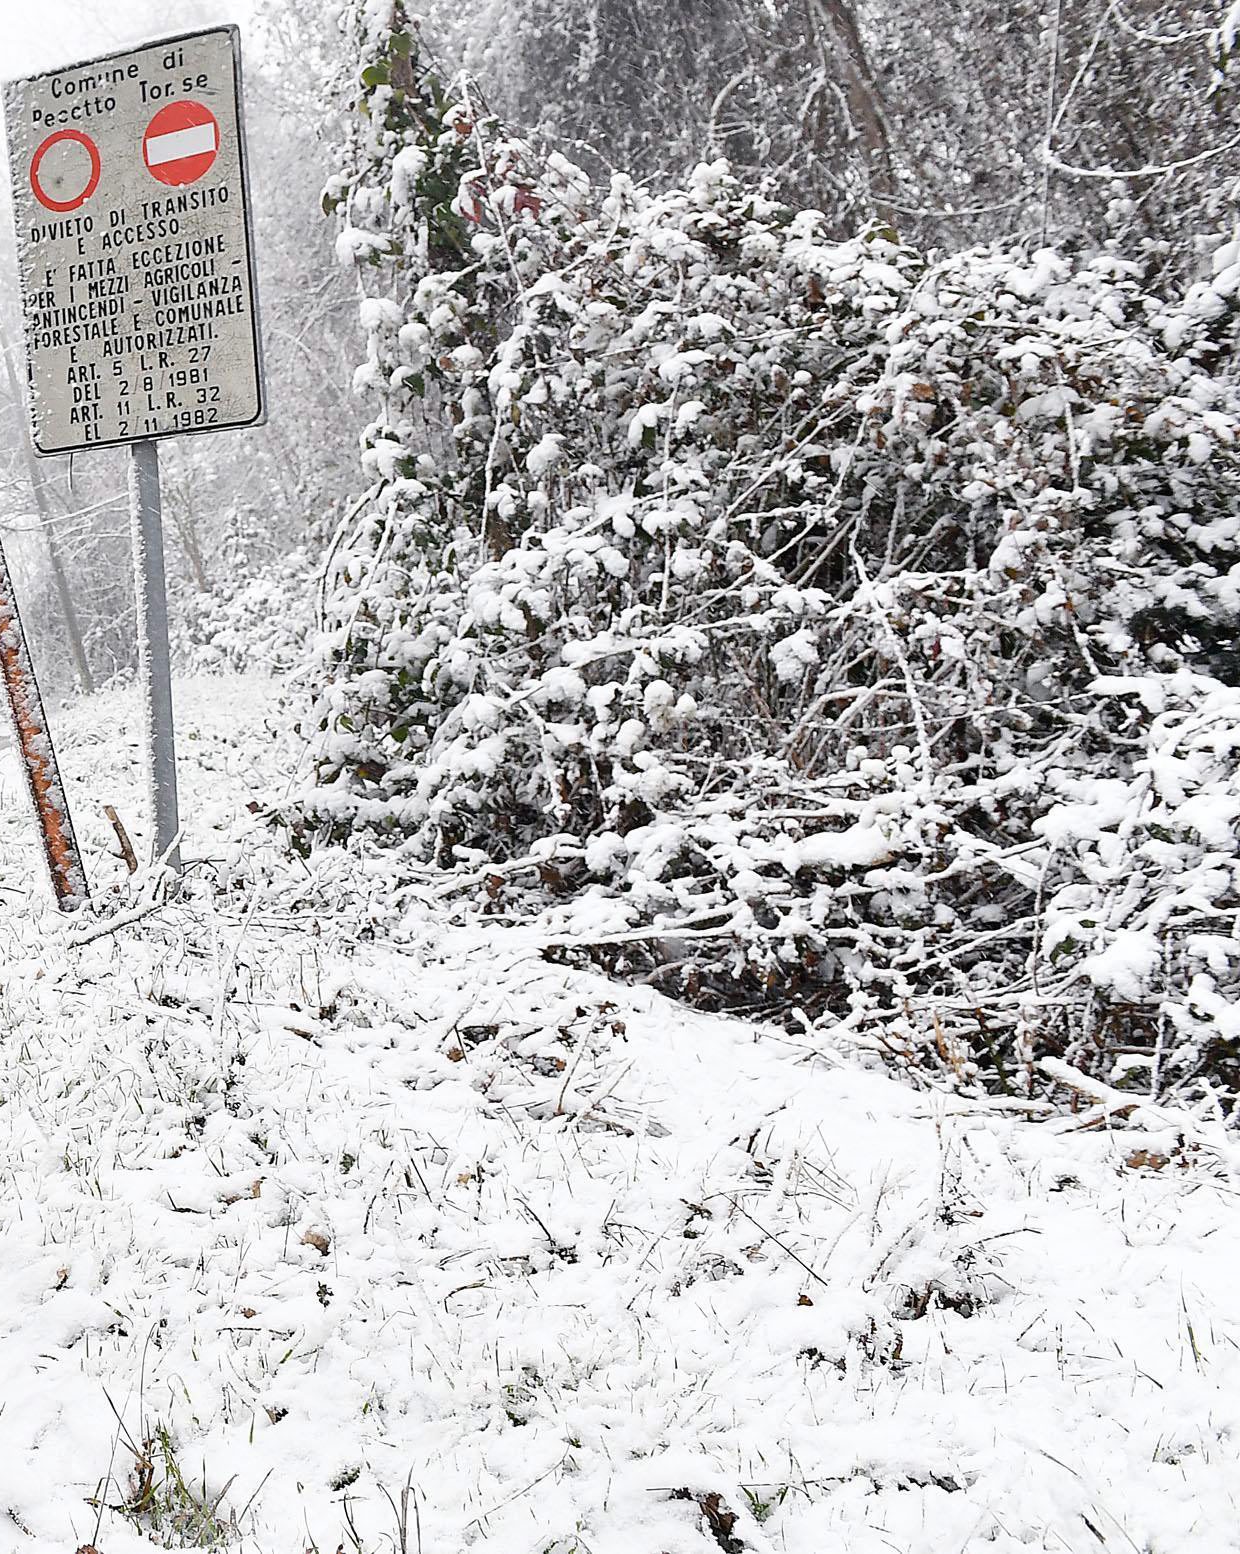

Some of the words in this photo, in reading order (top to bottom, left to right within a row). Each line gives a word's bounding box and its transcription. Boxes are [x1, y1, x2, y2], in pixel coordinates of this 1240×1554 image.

[163, 48, 183, 69] di
[31, 216, 93, 243] DIVIETO
[110, 209, 125, 227] DI
[142, 187, 228, 220] TRANSITO
[78, 238, 85, 255] E
[103, 219, 179, 249] ACCESSO
[69, 258, 115, 282] FATTA
[133, 234, 225, 269] ECCEZIONE
[70, 286, 74, 302] I
[88, 276, 129, 299] MEZZI
[144, 259, 214, 288] AGRICOLI
[152, 275, 242, 306] VIGILANZA
[34, 318, 118, 350] FORESTALE
[134, 314, 140, 331] E
[155, 293, 244, 327] COMUNALE
[71, 346, 77, 363] E
[103, 323, 218, 357] AUTORIZZATI.
[67, 363, 101, 384] ART.
[113, 361, 122, 376] 5
[189, 346, 210, 363] 27
[70, 403, 103, 424] ART.
[117, 402, 129, 416] 11
[196, 387, 220, 404] 32
[74, 383, 101, 403] DEL
